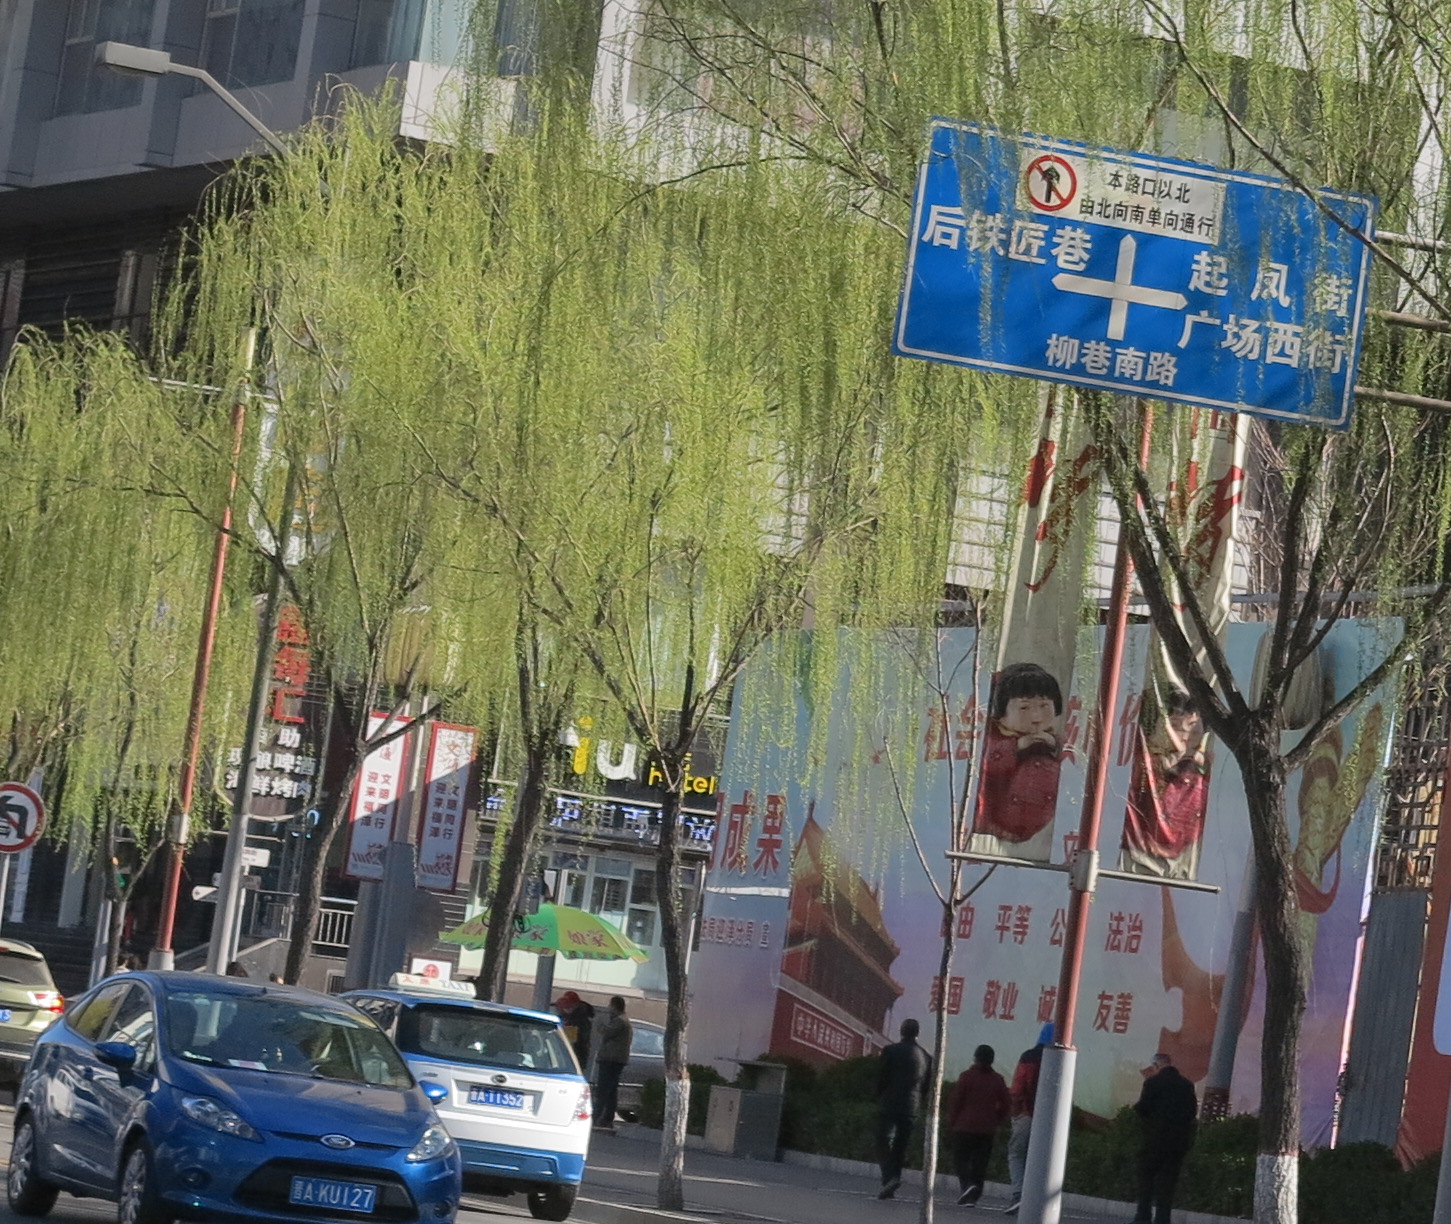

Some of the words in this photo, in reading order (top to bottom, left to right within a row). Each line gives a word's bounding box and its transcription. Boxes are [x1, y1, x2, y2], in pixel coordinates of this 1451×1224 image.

[1107, 170, 1191, 204] 本路口以北
[921, 204, 1094, 273] 后铁匠巷
[1079, 197, 1214, 237] 由北向南单向通行
[1045, 332, 1179, 388] 柳巷南路
[1177, 308, 1348, 376] 广场西街
[648, 761, 716, 795] htel
[995, 904, 1033, 945] 平等
[1105, 911, 1144, 954] 法治
[982, 979, 1019, 1022] 敬业
[1092, 990, 1135, 1035] 友善
